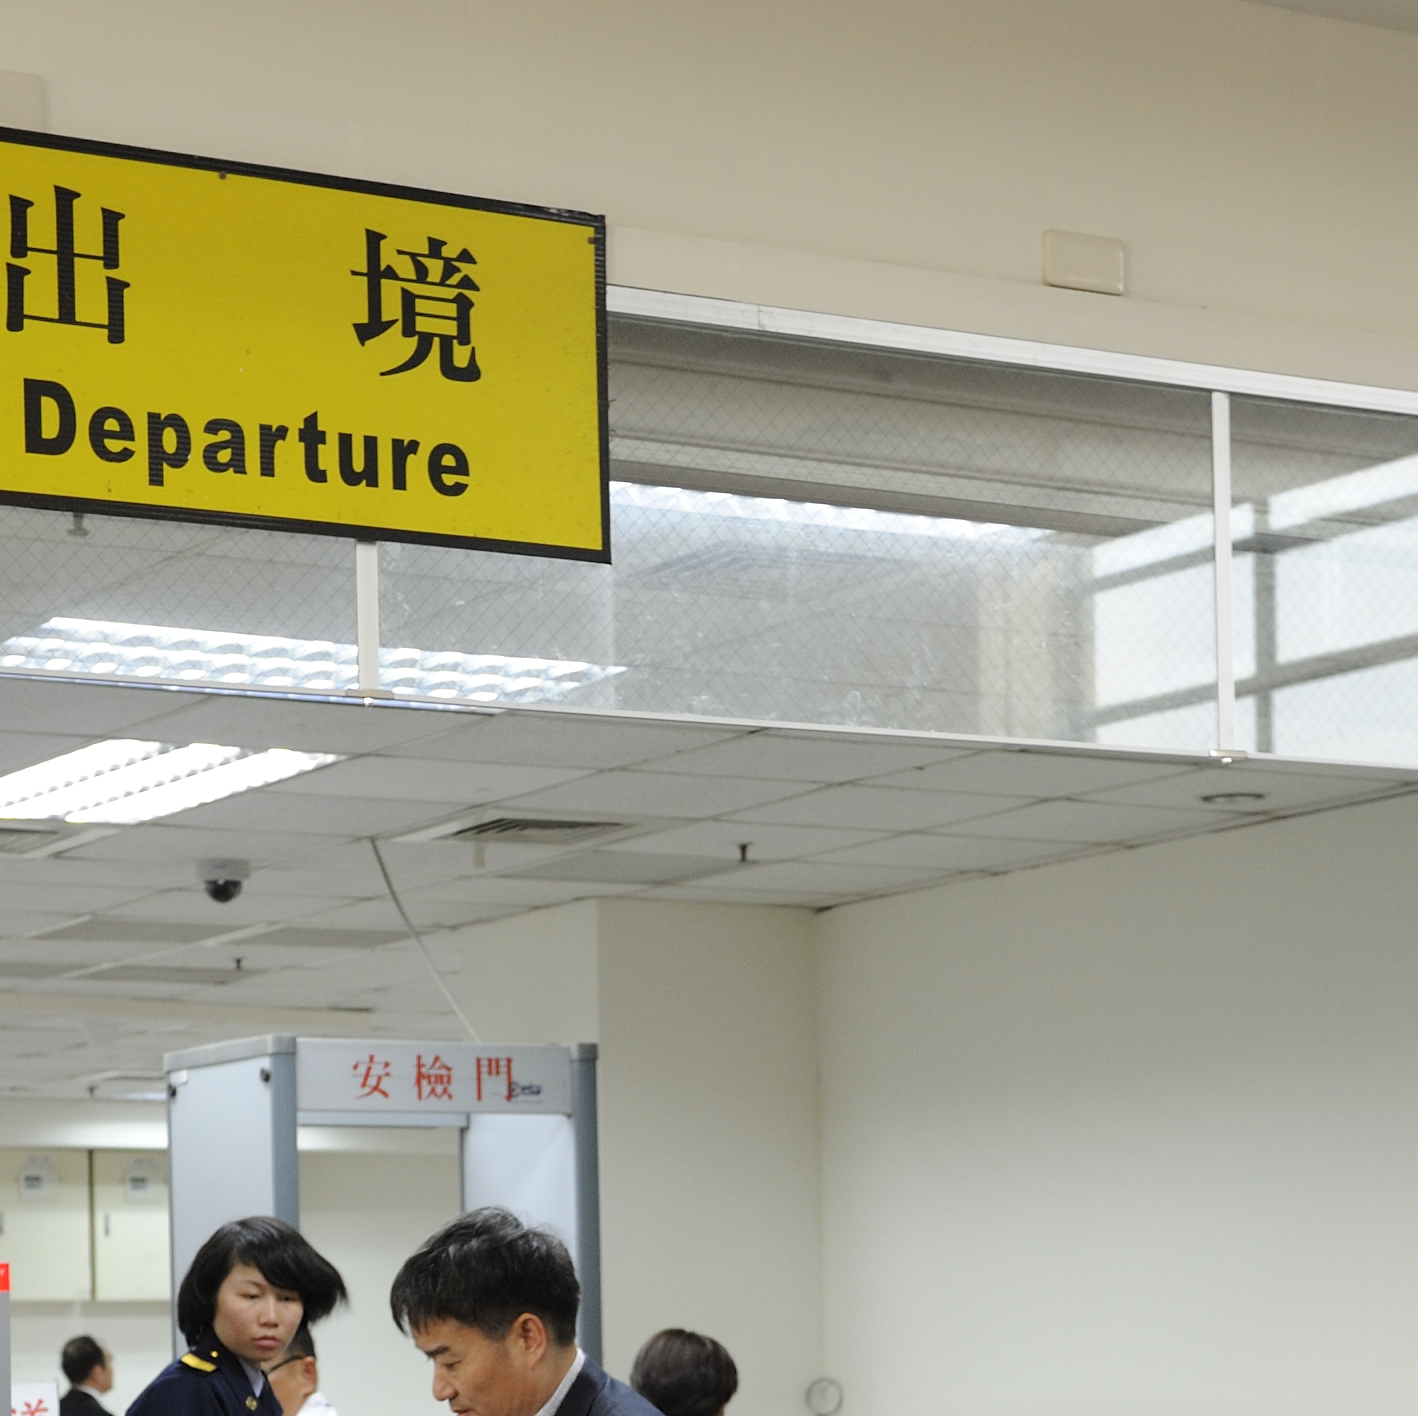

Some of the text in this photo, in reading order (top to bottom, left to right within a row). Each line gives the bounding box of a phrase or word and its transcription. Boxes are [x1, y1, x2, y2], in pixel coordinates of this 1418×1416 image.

[5, 185, 482, 383] 出境
[23, 377, 471, 498] Departure
[352, 1054, 513, 1102] 安檢門
